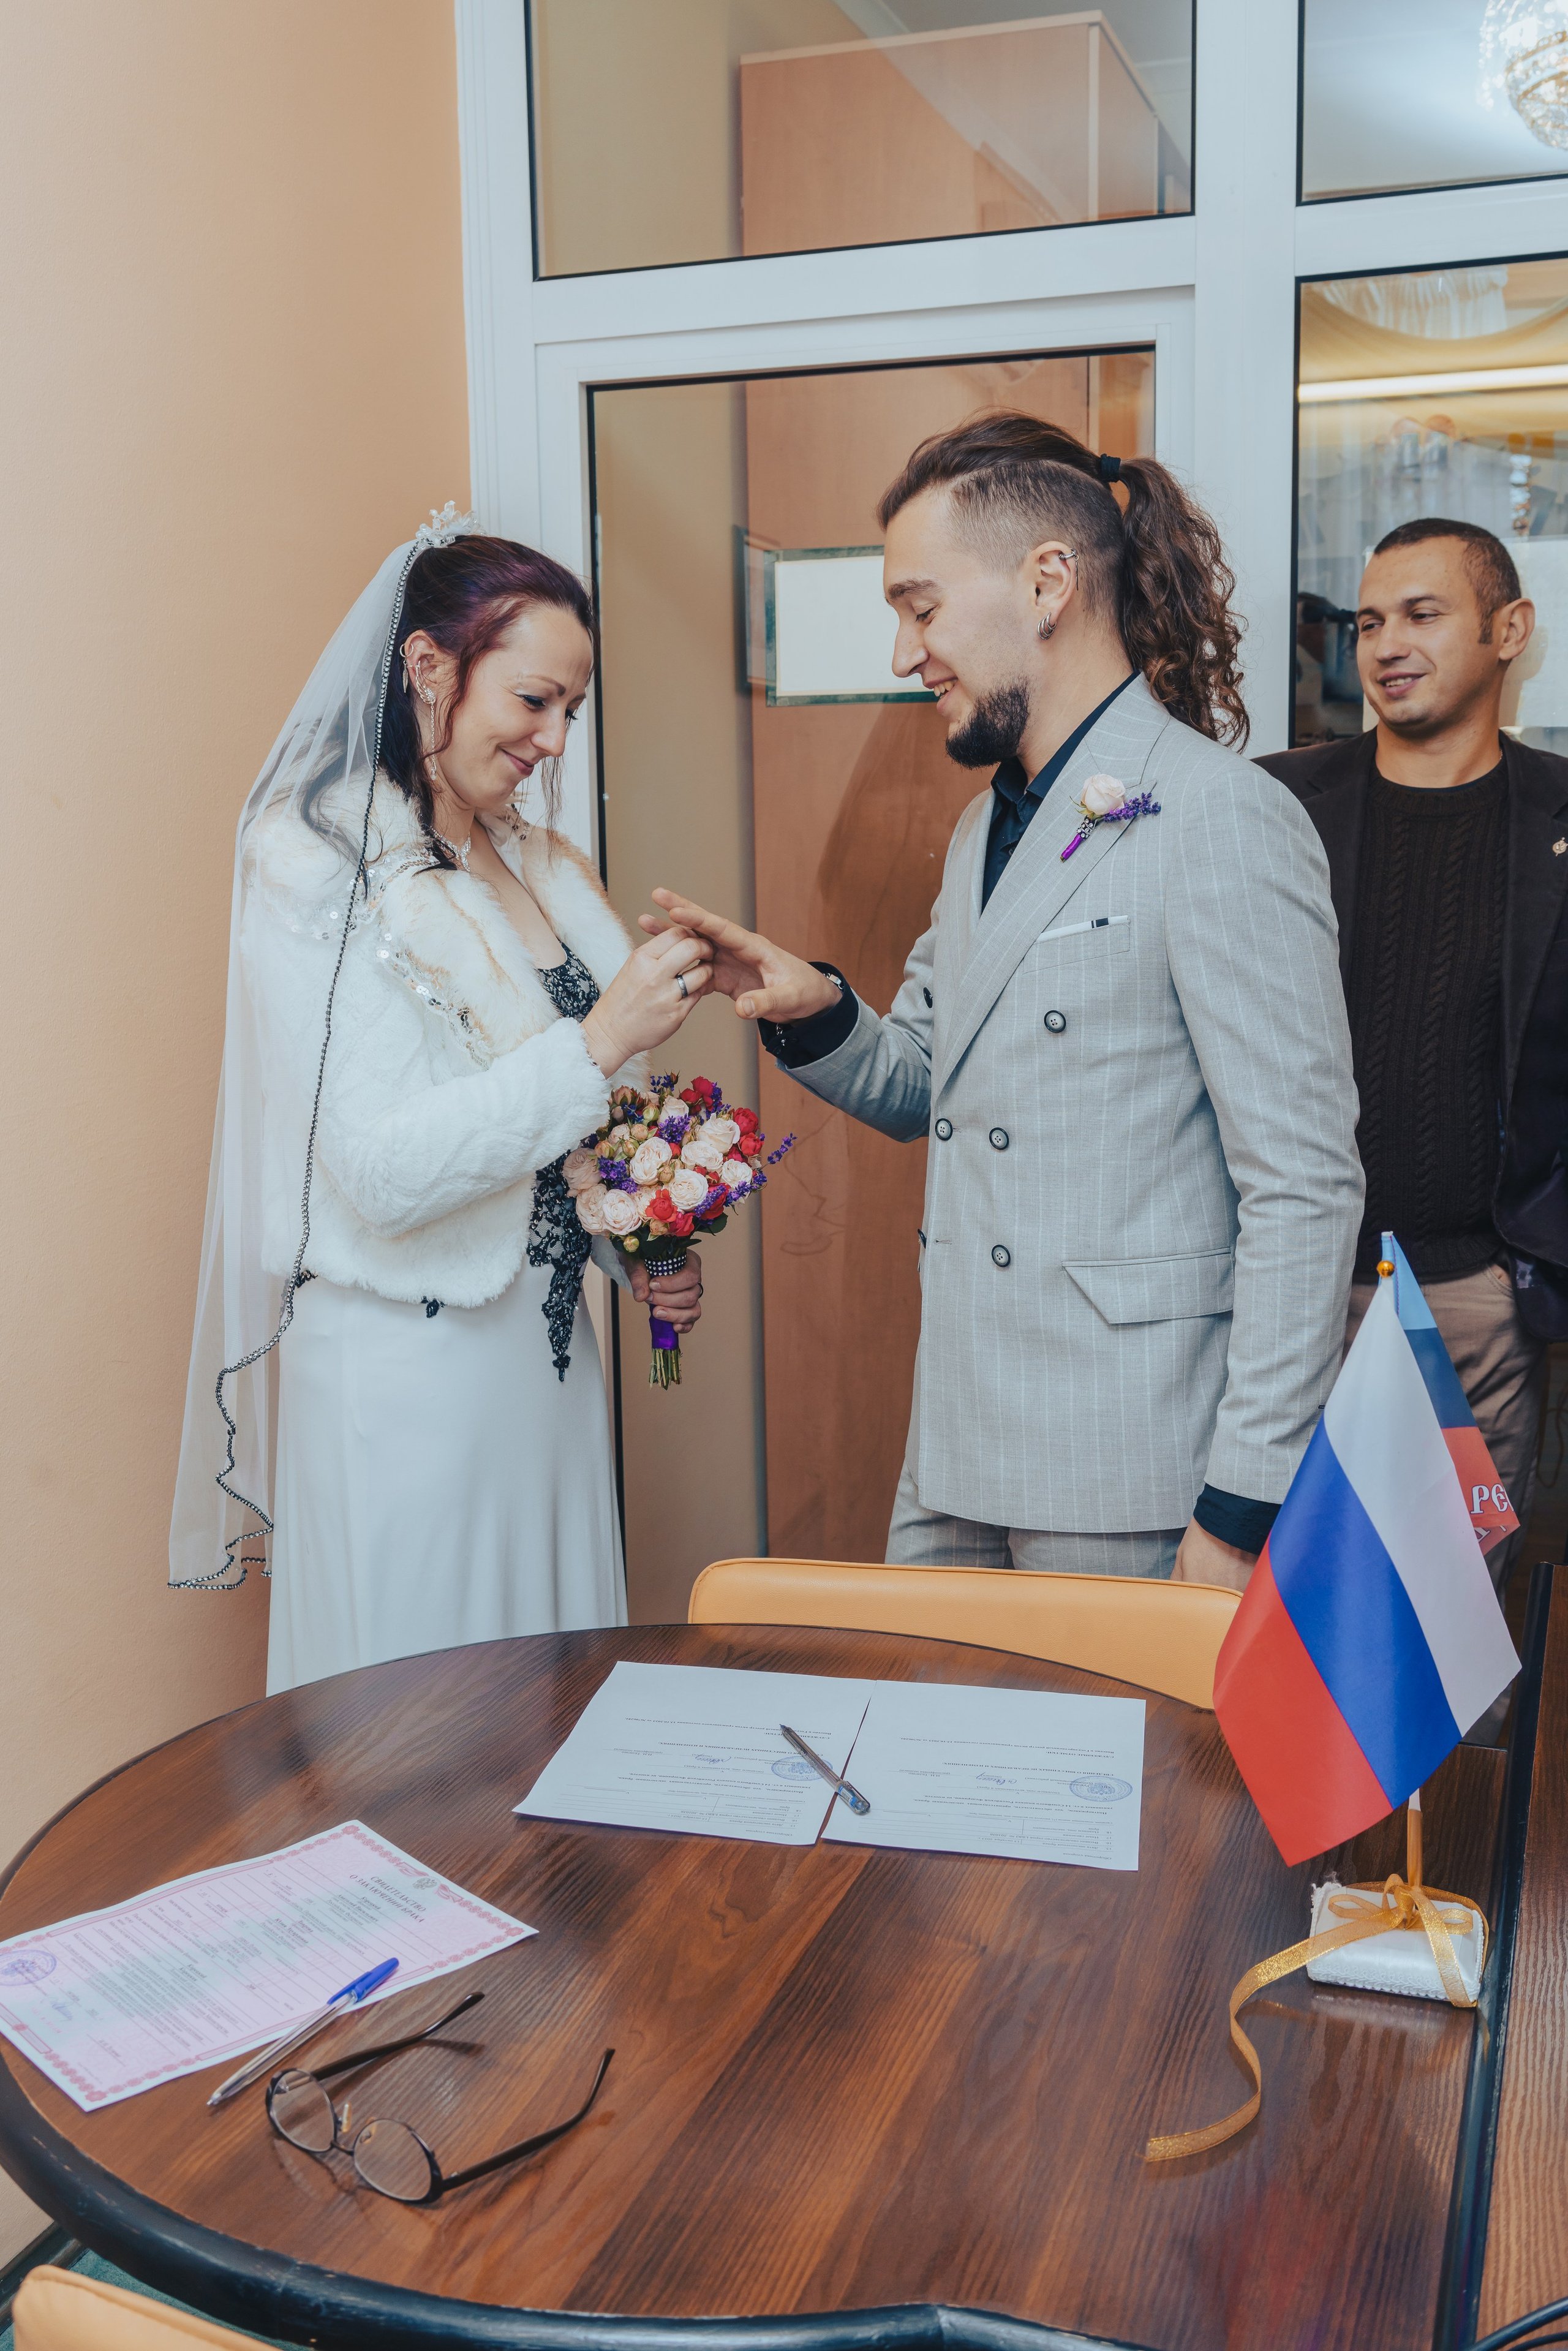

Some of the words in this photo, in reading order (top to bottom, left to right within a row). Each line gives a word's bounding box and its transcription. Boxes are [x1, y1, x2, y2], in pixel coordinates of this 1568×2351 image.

[1470, 1484, 1514, 1514] РЕ
[355, 1878, 403, 1908] ЗАКЛЮЧЕНИИ
[401, 1907, 424, 1923] БРАКА
[370, 1876, 426, 1911] СВИДЕТЕЛЬСТВО
